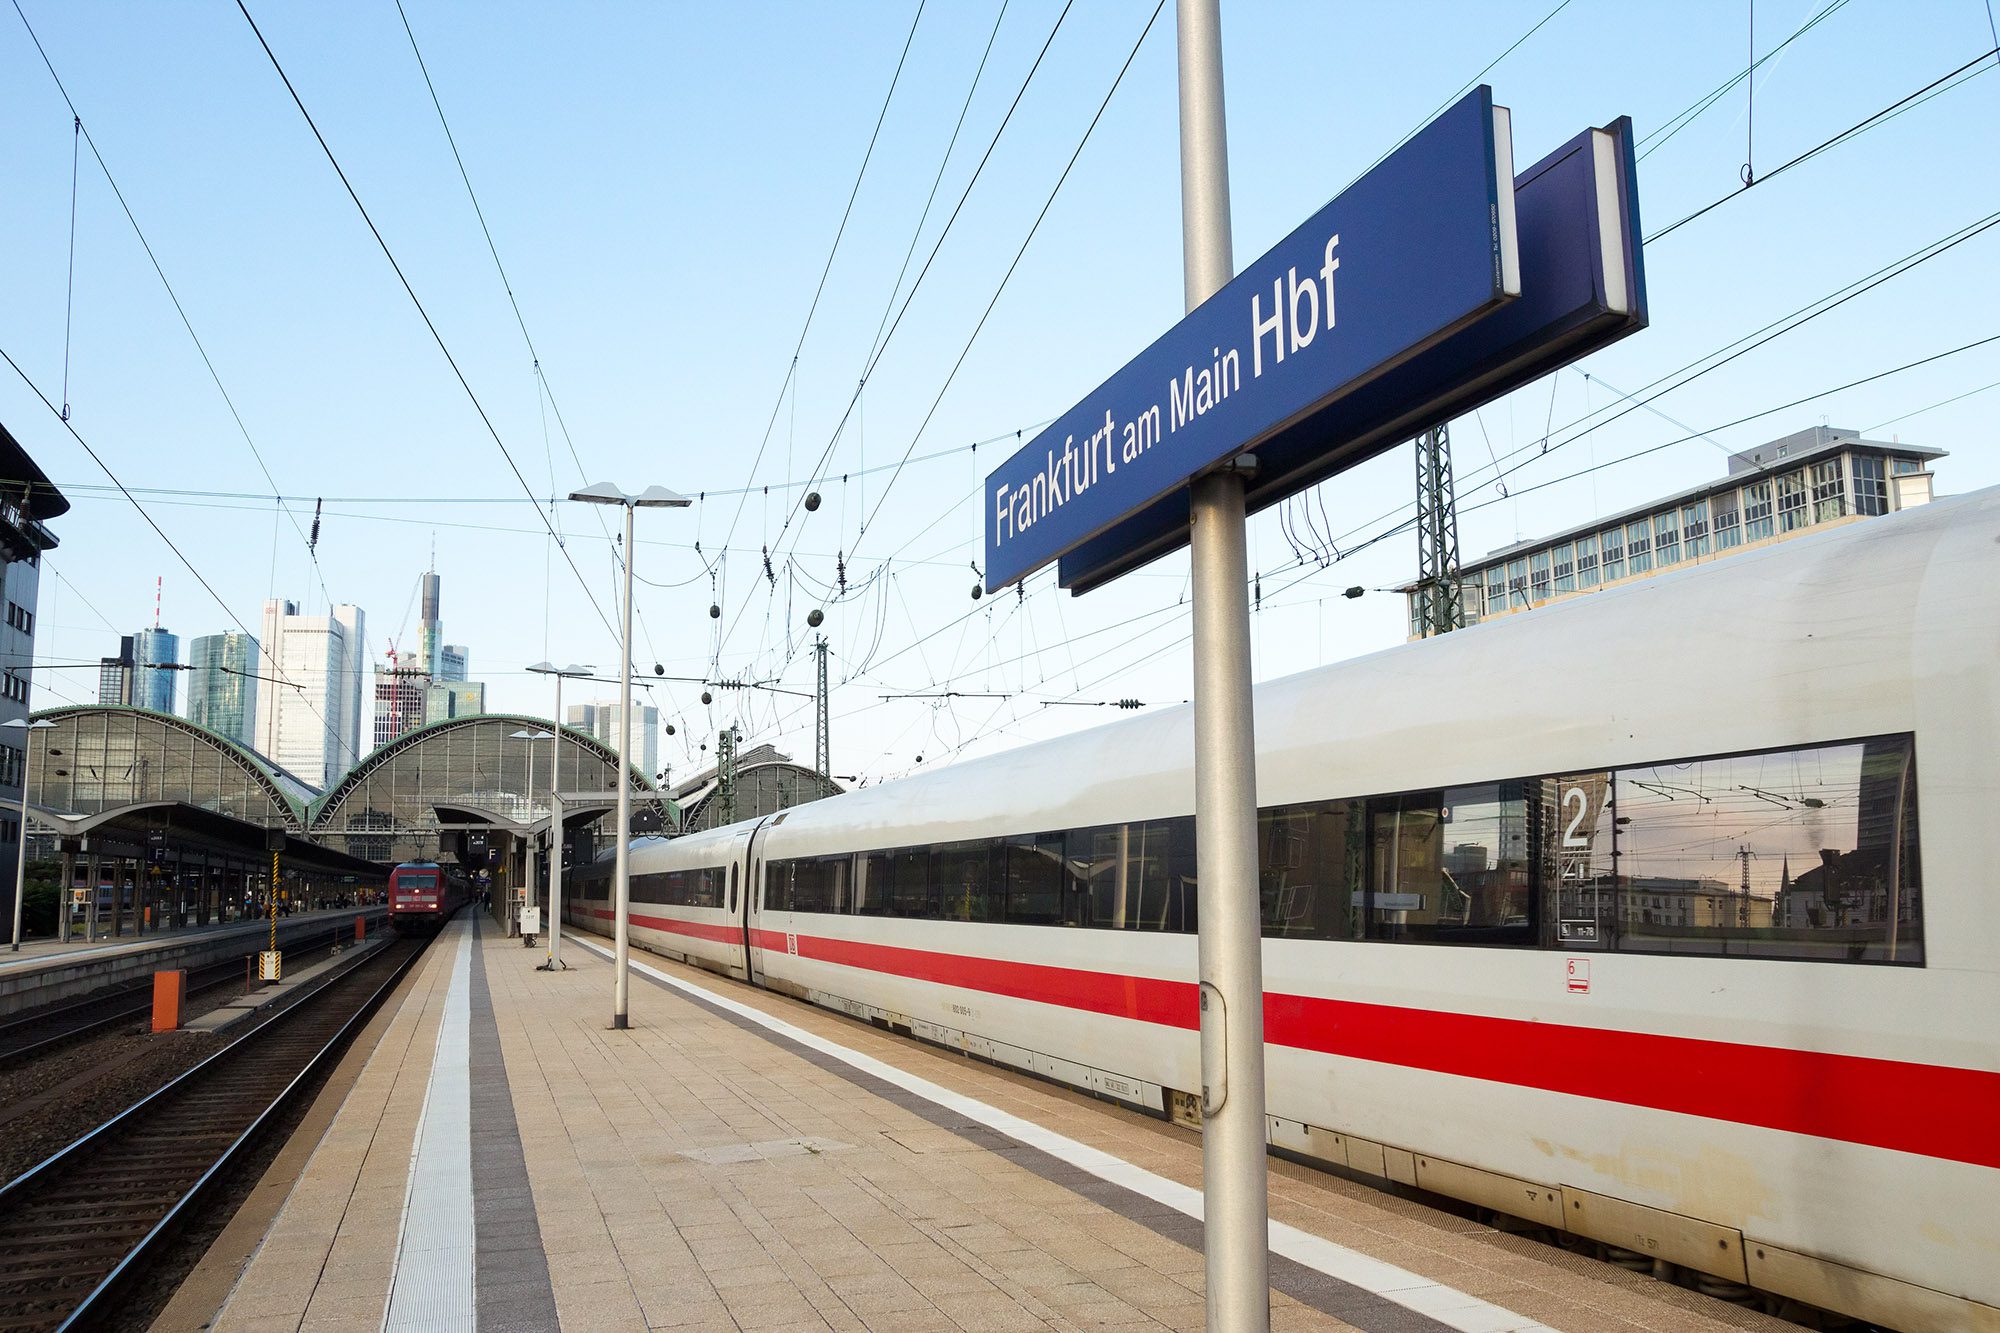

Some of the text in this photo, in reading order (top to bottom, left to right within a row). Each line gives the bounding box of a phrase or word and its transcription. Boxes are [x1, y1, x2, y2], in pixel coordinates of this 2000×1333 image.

[995, 234, 1340, 547] Frankfurt am Main Hbf
[1562, 787, 1588, 847] 2
[488, 849, 497, 860] F
[1568, 961, 1575, 975] 6
